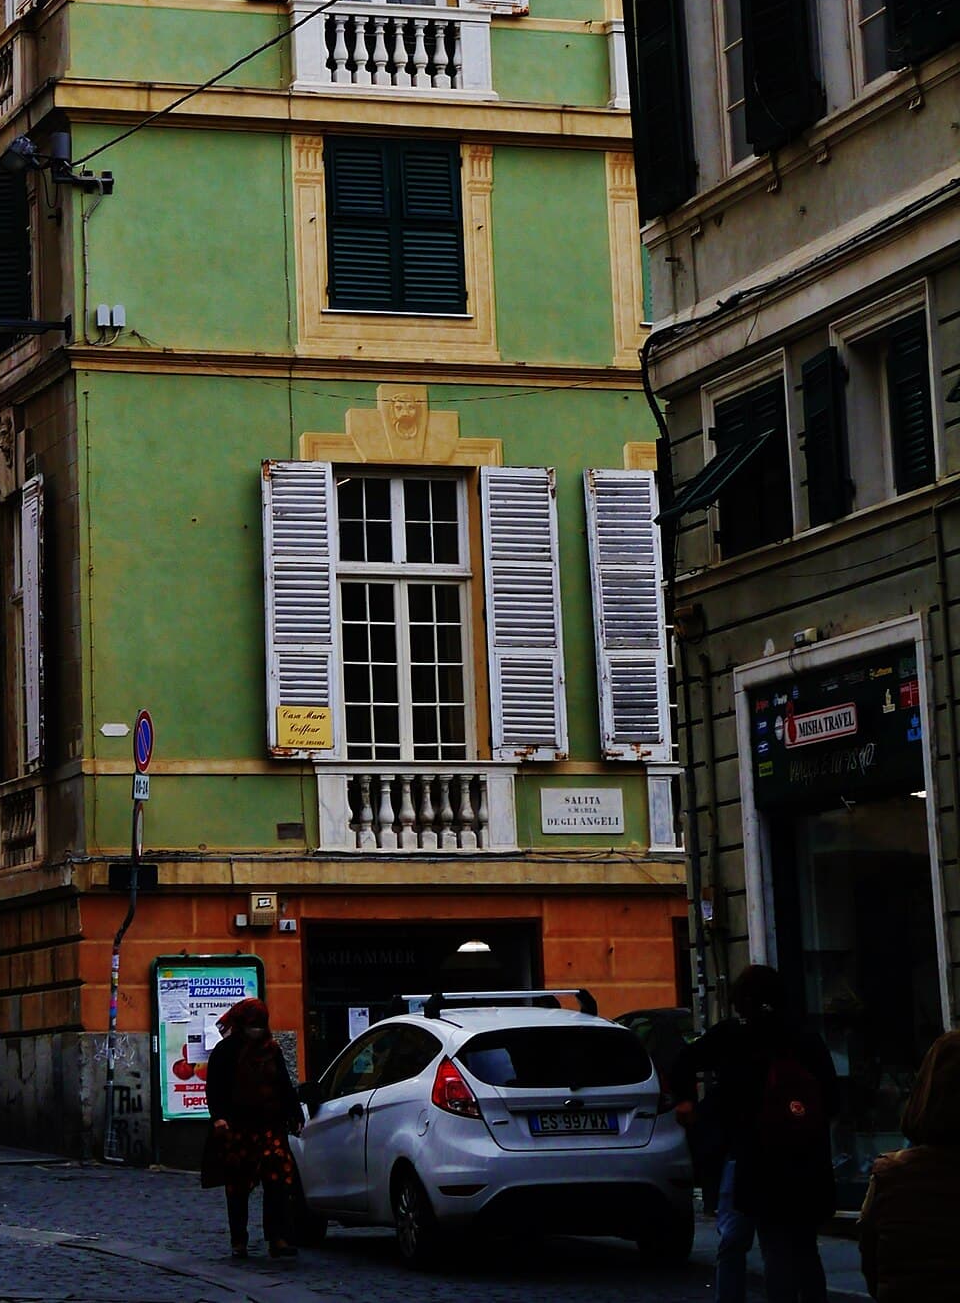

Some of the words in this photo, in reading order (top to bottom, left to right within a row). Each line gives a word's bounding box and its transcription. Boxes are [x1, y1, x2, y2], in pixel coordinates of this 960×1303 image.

[282, 709, 301, 719] Casa
[798, 718, 823, 738] MISHA
[824, 710, 854, 733] TRAVEL
[290, 723, 320, 736] Coiffeur
[564, 796, 601, 805] SALITA
[547, 817, 577, 826] DEGLI
[579, 816, 619, 826] ANGELI
[284, 920, 291, 930] 4
[194, 987, 242, 996] RISPARMIO
[540, 1113, 558, 1130] ES
